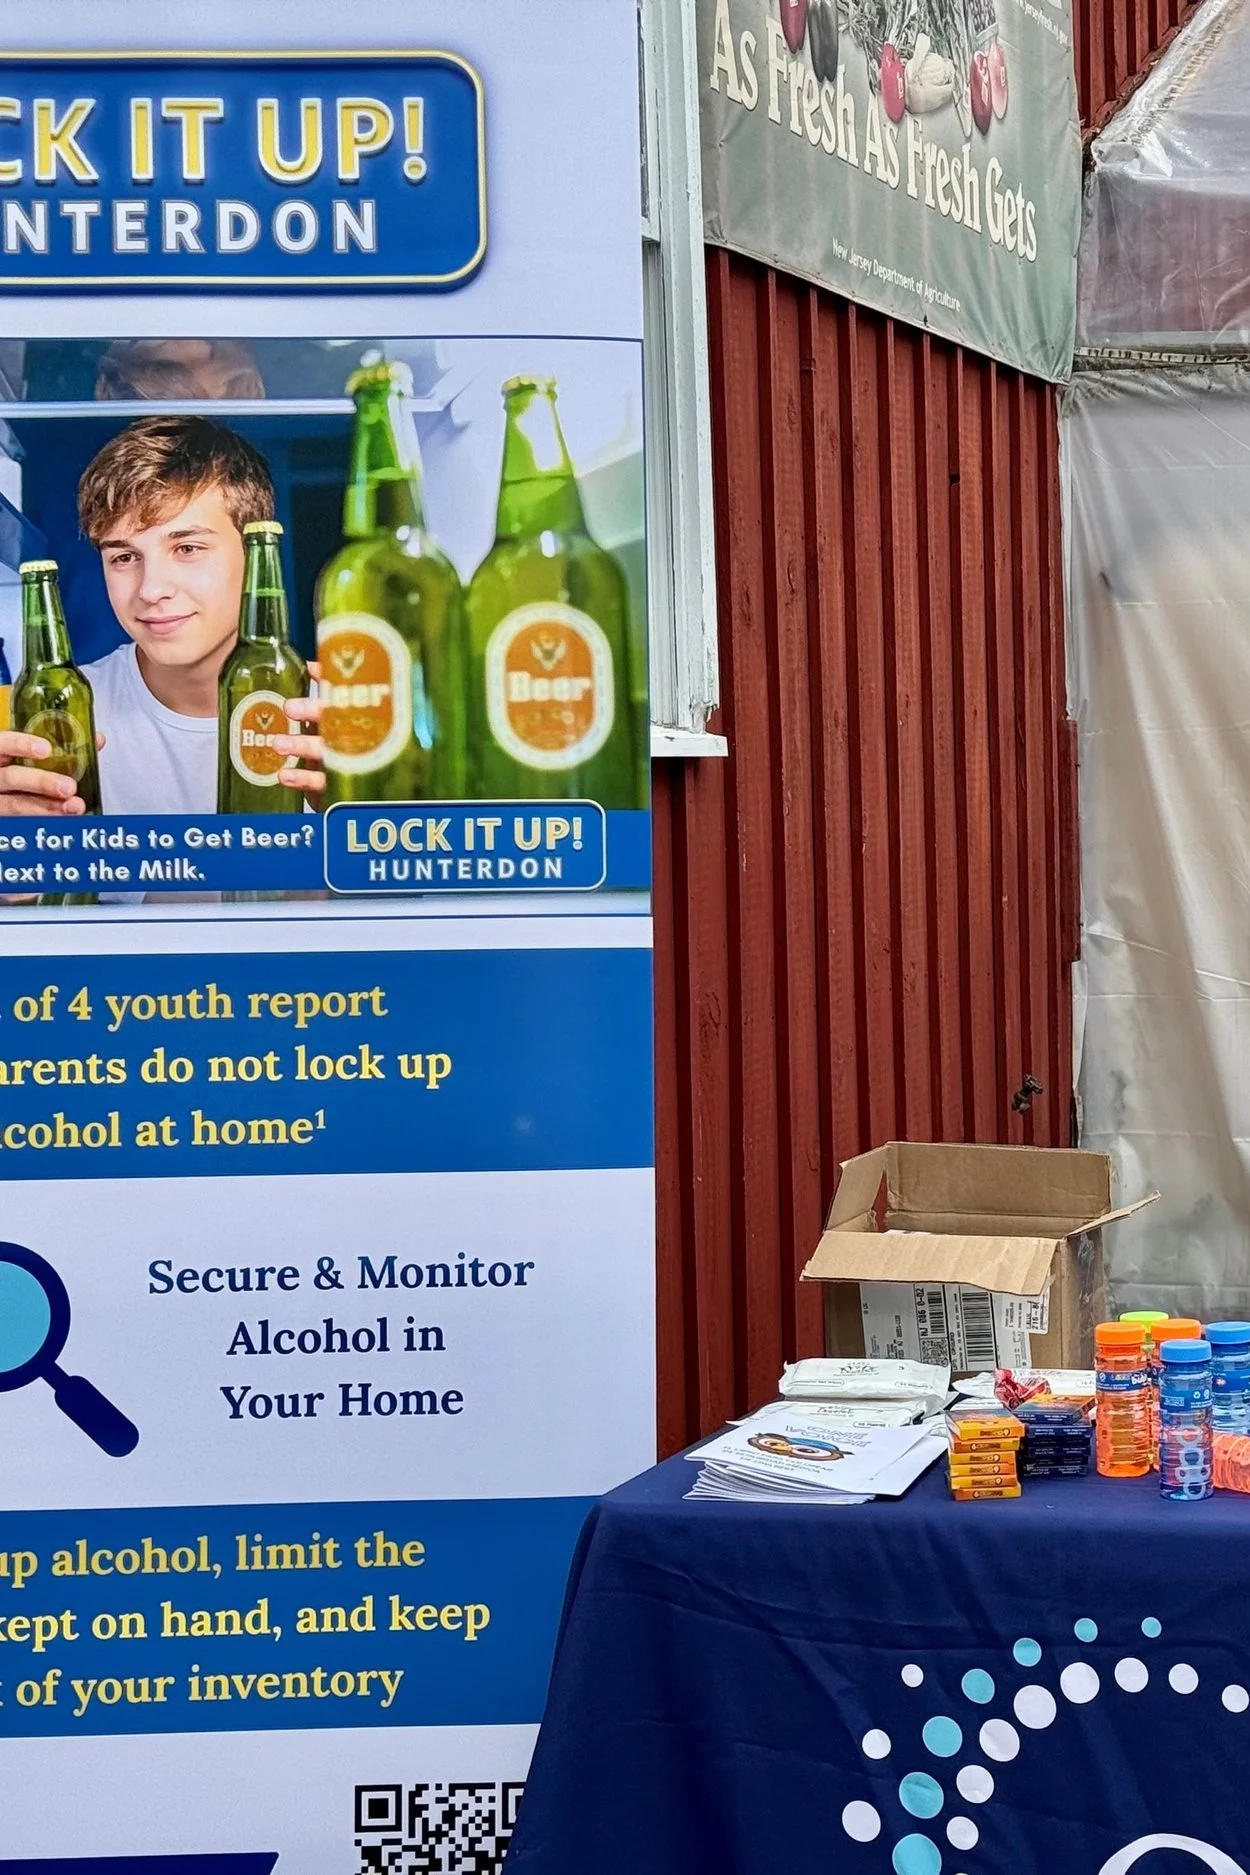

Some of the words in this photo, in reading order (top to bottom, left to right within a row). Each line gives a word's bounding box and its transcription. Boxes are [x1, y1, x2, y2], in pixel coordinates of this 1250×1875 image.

[130, 97, 224, 183] IT
[256, 97, 426, 184] UP!
[711, 0, 758, 111] As
[766, 17, 858, 169] Fresh
[864, 94, 900, 190] As
[907, 118, 981, 234] Fresh
[985, 157, 1036, 262] Gets
[4, 199, 379, 255] NTERDON
[832, 237, 848, 261] New
[849, 247, 872, 276] Jersey
[873, 258, 915, 292] Department
[916, 279, 924, 295] of
[924, 282, 961, 312] Agriculture
[507, 670, 591, 702] Beer
[242, 729, 275, 747] Bee
[35, 827, 74, 850] for
[82, 827, 140, 849] Kids
[148, 828, 175, 848] to
[184, 826, 233, 848] Get
[241, 824, 315, 848] Beer?
[347, 818, 453, 853] LOCK
[464, 818, 502, 851] IT
[514, 817, 583, 851] UP!
[0, 862, 45, 883] ext
[53, 862, 79, 882] to
[88, 859, 130, 881] the
[139, 858, 206, 881] Milk.
[368, 857, 564, 882] HUNTERDON
[13, 984, 60, 1023] of
[67, 986, 93, 1021] 4
[104, 983, 234, 1033] youth
[248, 986, 388, 1028] report
[141, 1048, 195, 1084] do
[208, 1049, 283, 1083] not
[295, 1046, 385, 1081] lock
[397, 1051, 453, 1089] up
[0, 1111, 122, 1150] cohol
[135, 1116, 180, 1147] at
[148, 1258, 301, 1294] Secure
[313, 1256, 344, 1291] &
[357, 1252, 535, 1290] Monitor
[226, 1317, 390, 1355] Alcohol
[403, 1316, 446, 1352] in
[220, 1384, 325, 1420] Your
[338, 1381, 465, 1417] Home
[51, 1536, 222, 1579] alcohol,
[235, 1532, 341, 1571] limit
[354, 1531, 425, 1567] the
[92, 1611, 147, 1641] on
[161, 1599, 282, 1641] hand,
[296, 1596, 376, 1634] and
[389, 1594, 490, 1641] keep
[16, 1668, 62, 1707] of
[70, 1672, 175, 1717] your
[188, 1662, 404, 1707] inventory
